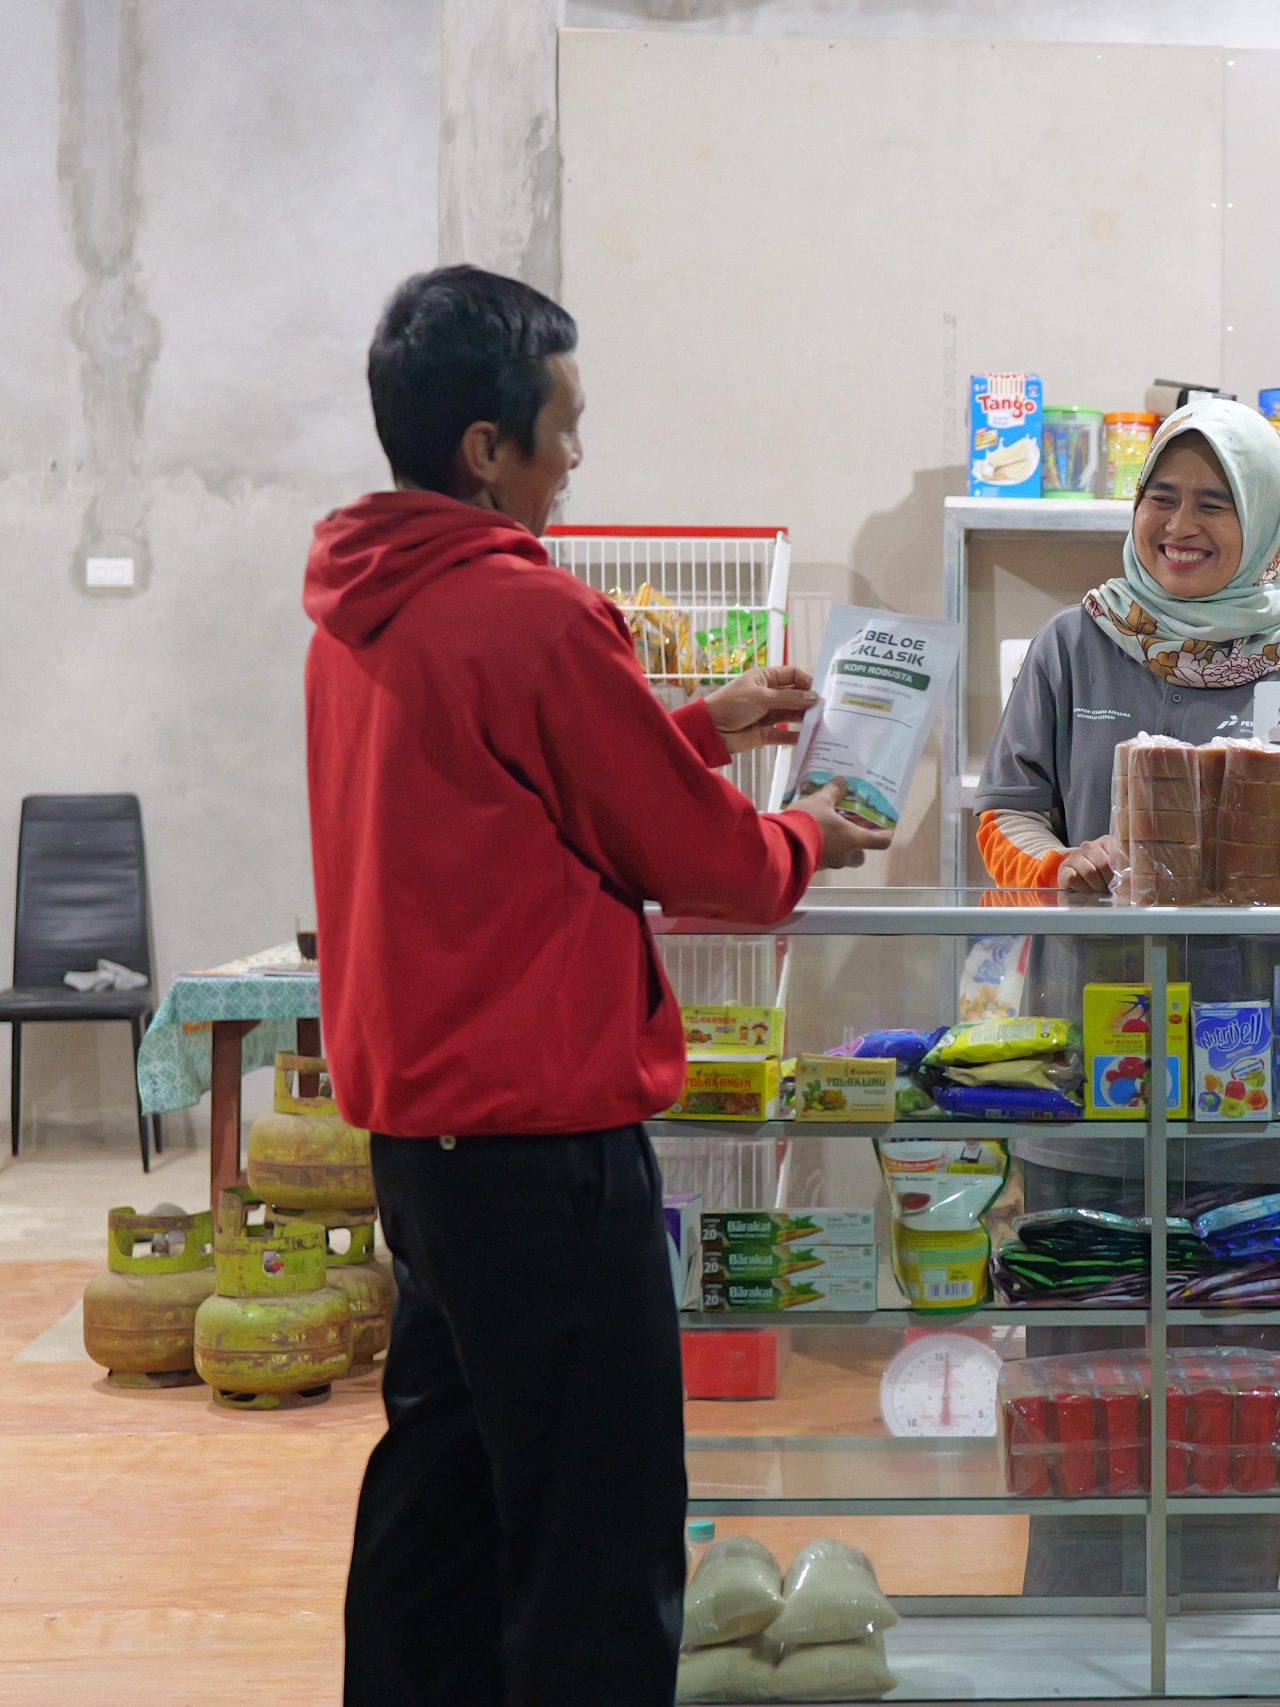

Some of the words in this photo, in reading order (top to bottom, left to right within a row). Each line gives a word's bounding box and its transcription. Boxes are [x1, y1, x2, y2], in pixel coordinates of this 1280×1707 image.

[978, 395, 1035, 418] Tango
[865, 630, 926, 651] BELOE
[859, 644, 925, 667] KLASIK
[843, 663, 866, 673] KOPI
[867, 666, 913, 683] ROBUSTA
[1201, 1007, 1263, 1050] Nutrijell
[703, 1229, 718, 1240] 20
[935, 1353, 944, 1361] 15
[907, 1418, 917, 1427] 10
[978, 1410, 984, 1418] 5
